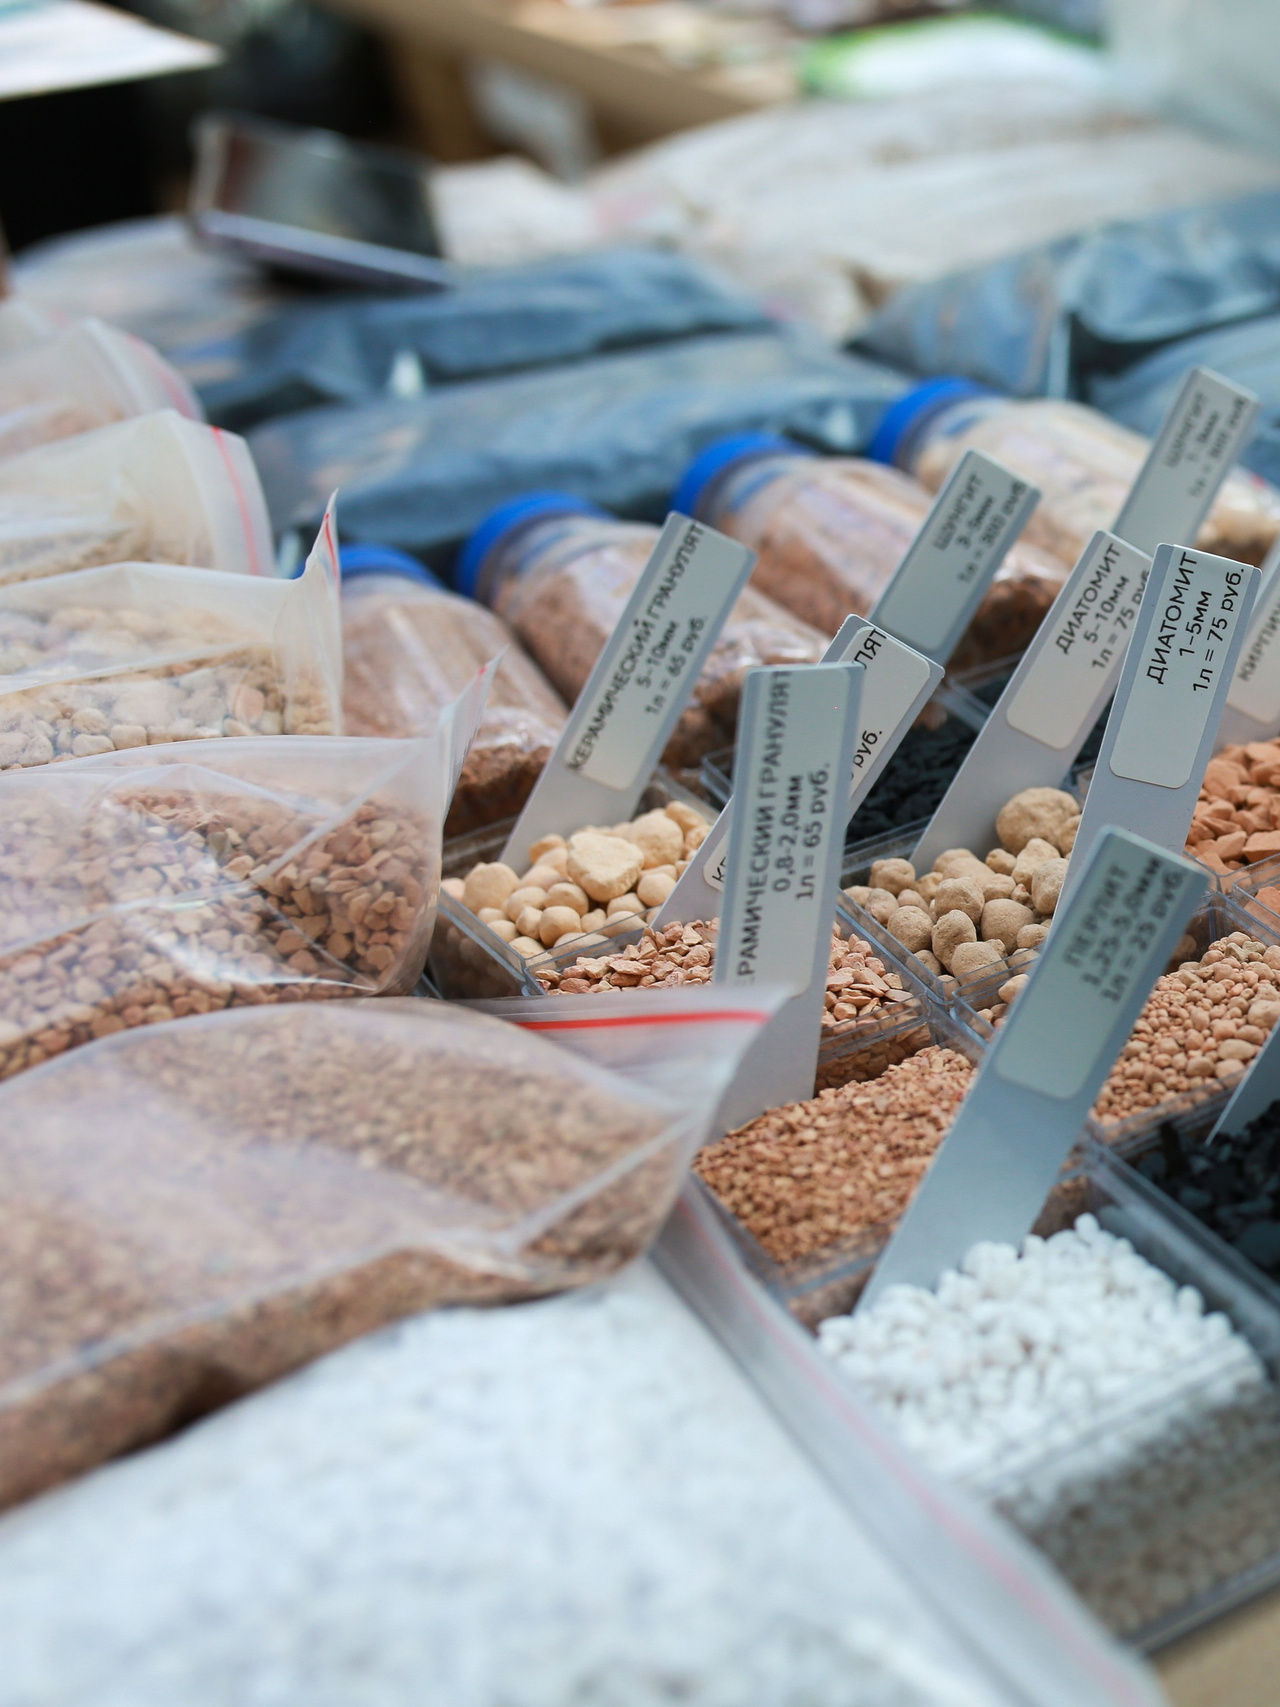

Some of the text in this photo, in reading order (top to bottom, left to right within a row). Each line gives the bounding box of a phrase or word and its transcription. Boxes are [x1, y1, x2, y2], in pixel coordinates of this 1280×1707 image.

[647, 523, 704, 620] ГРАНУЛЯТ
[1055, 543, 1121, 655] ДИАТОМИТ
[1084, 575, 1130, 644] 5-10мм
[1146, 551, 1197, 685] ДИАТОМИТ
[1092, 650, 1113, 669] 1л
[1115, 607, 1135, 630] 75
[1179, 590, 1212, 656] 1-5мм
[1193, 668, 1213, 691] 1л
[1207, 616, 1228, 642] 75
[1220, 568, 1244, 612] руб.
[758, 670, 792, 798] ГРАНУЛЯТ
[772, 775, 804, 893] 0,8-2,0мм
[807, 820, 824, 849] 65
[811, 762, 831, 814] руб.
[796, 875, 815, 900] 1л
[1062, 863, 1129, 968] ПЕРЛИТ
